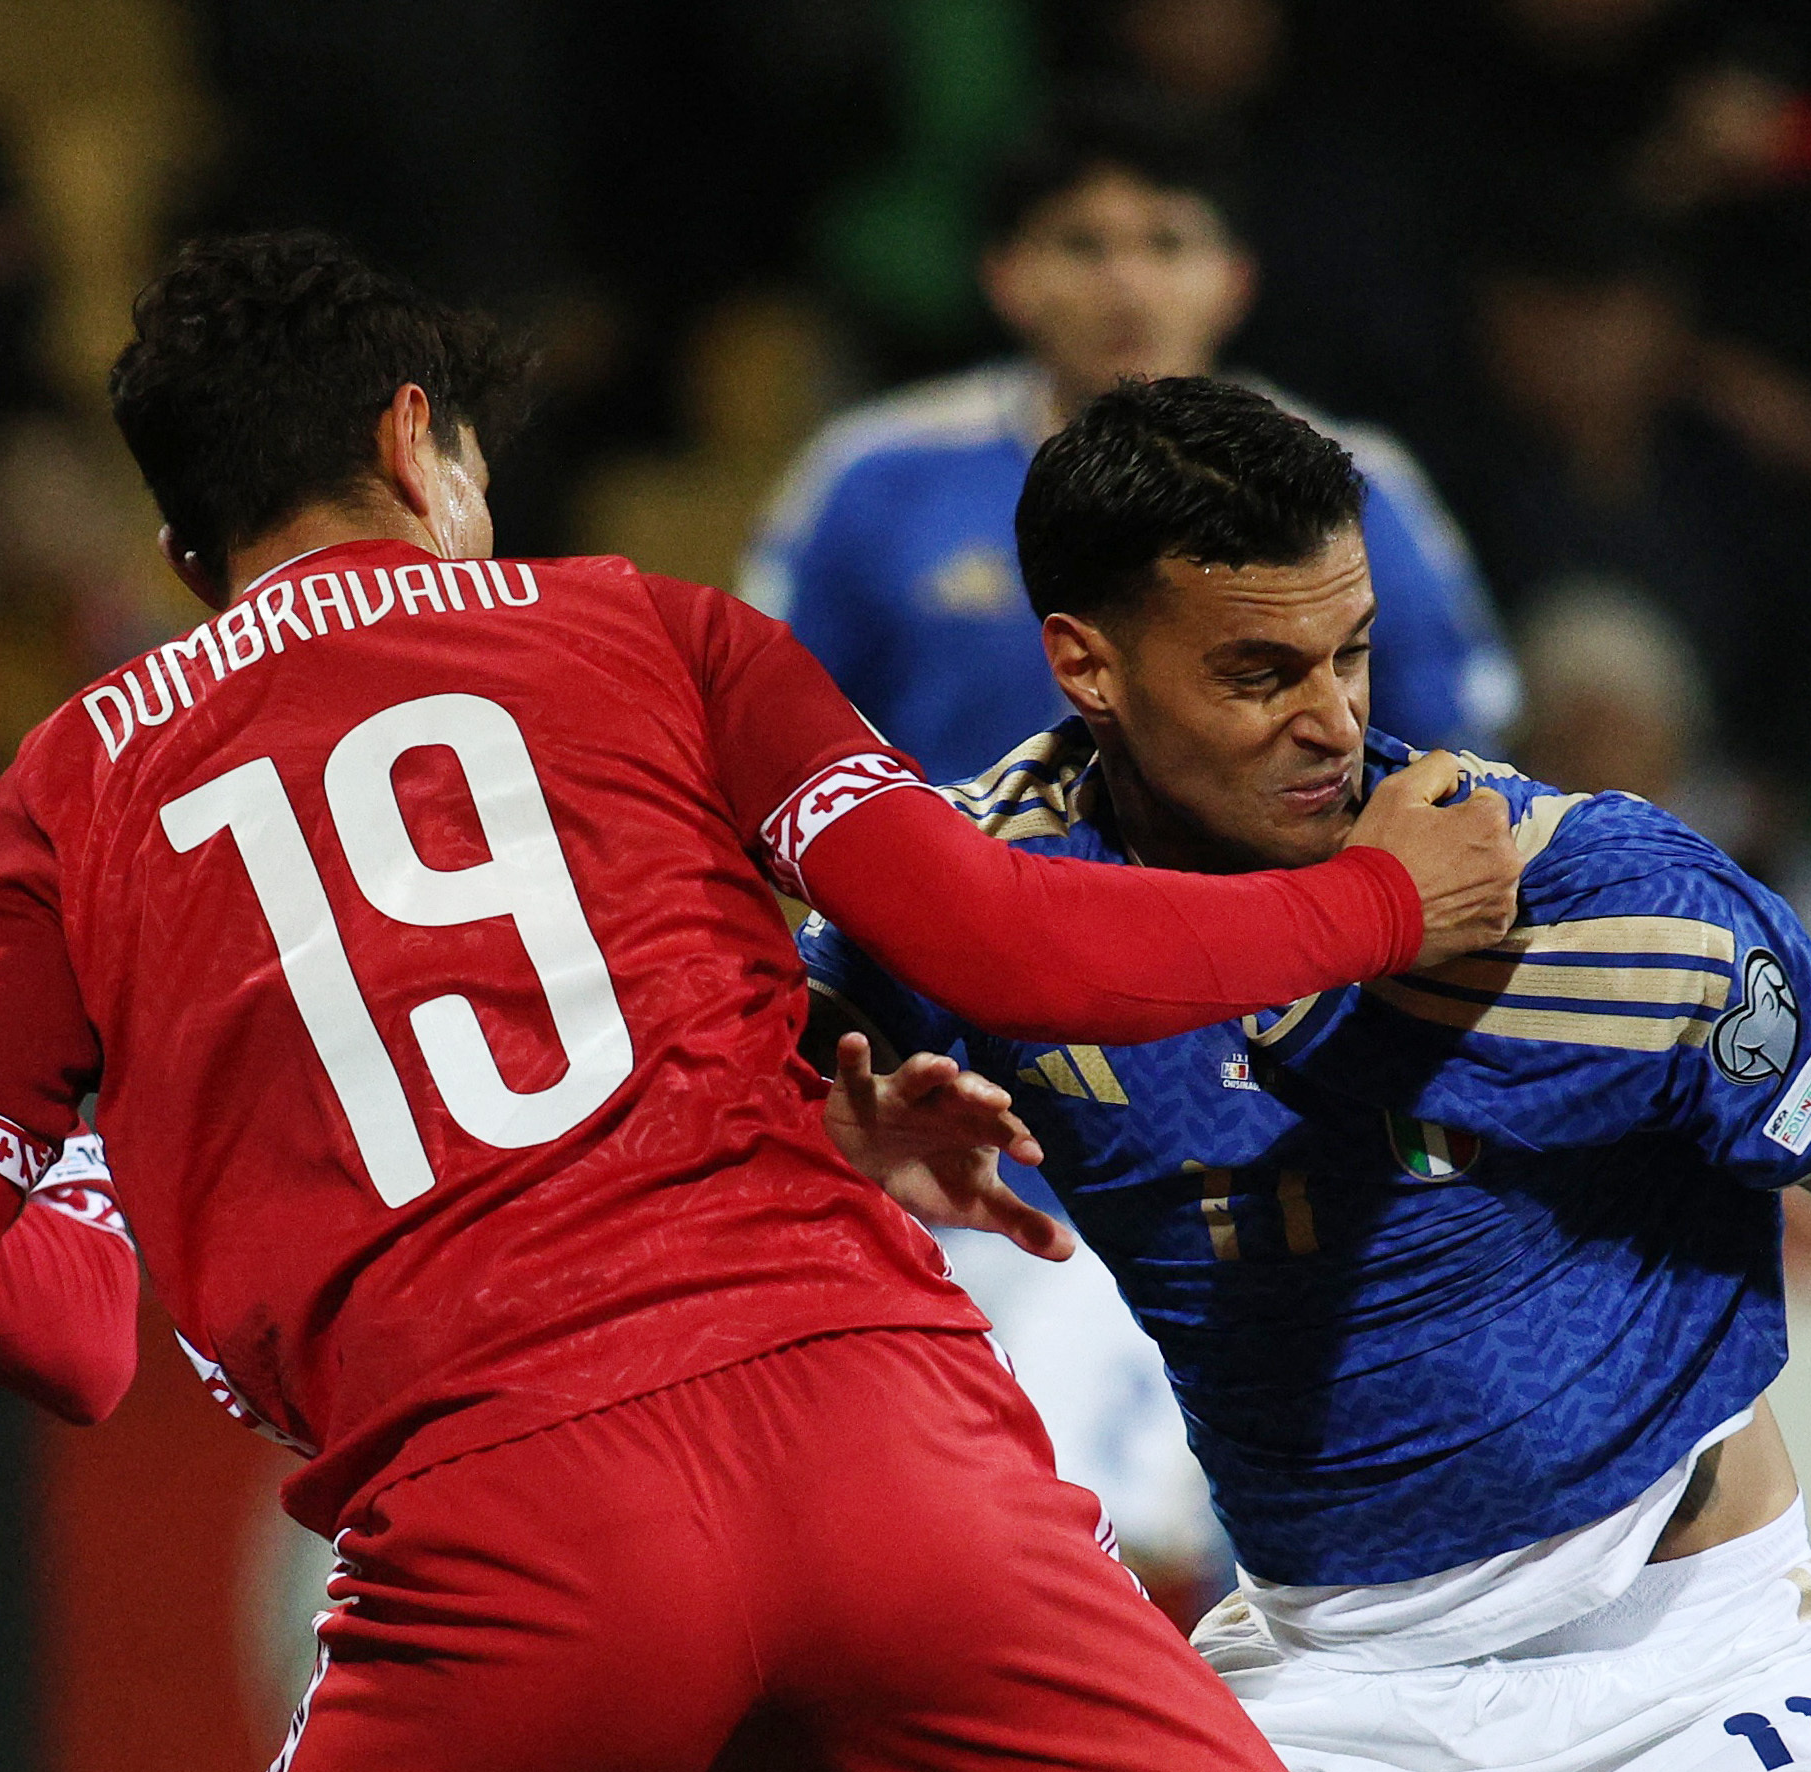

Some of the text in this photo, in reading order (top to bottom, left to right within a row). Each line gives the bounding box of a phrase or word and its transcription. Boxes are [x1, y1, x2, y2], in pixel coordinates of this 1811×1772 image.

[82, 558, 540, 764] DUMBRAVANU
[158, 692, 634, 1209] 19
[1180, 1158, 1321, 1262] 11
